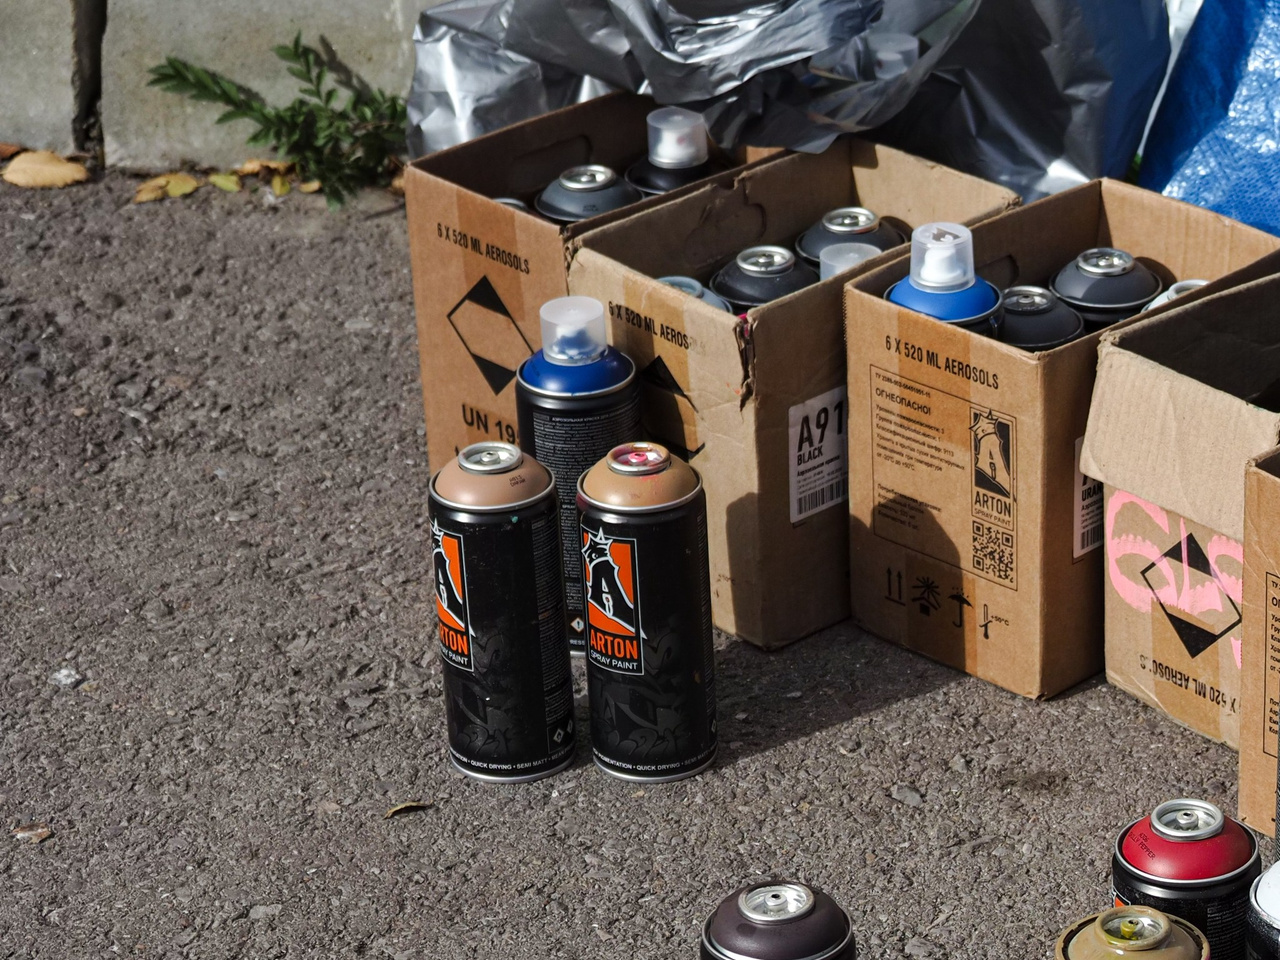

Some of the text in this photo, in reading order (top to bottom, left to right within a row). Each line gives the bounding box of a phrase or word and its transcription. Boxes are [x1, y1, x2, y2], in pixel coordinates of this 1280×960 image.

[437, 223, 530, 275] 6 X 520 ML AEROSOLS
[608, 301, 614, 316] 6
[616, 304, 622, 320] X
[625, 308, 642, 328] 520
[644, 316, 657, 335] ML
[885, 335, 999, 390] 6 X 520 ML AEROSOLS
[875, 387, 931, 416] ОГНЕОПАСНО!
[462, 404, 516, 445] UN 19
[797, 401, 844, 453] A91
[797, 445, 823, 466] BLACK
[975, 490, 1011, 518] ARTON
[974, 508, 1012, 528] SPRAY PAINT
[590, 629, 638, 660] ARTON
[449, 651, 469, 667] PAINT
[591, 650, 638, 671] SPRAY PAINT
[1140, 654, 1190, 690] AEROSOS
[1192, 678, 1206, 699] ML
[1209, 686, 1226, 708] 520
[471, 760, 488, 769] QUICK
[657, 762, 680, 770] DRYING
[1138, 841, 1156, 860] PEPPER
